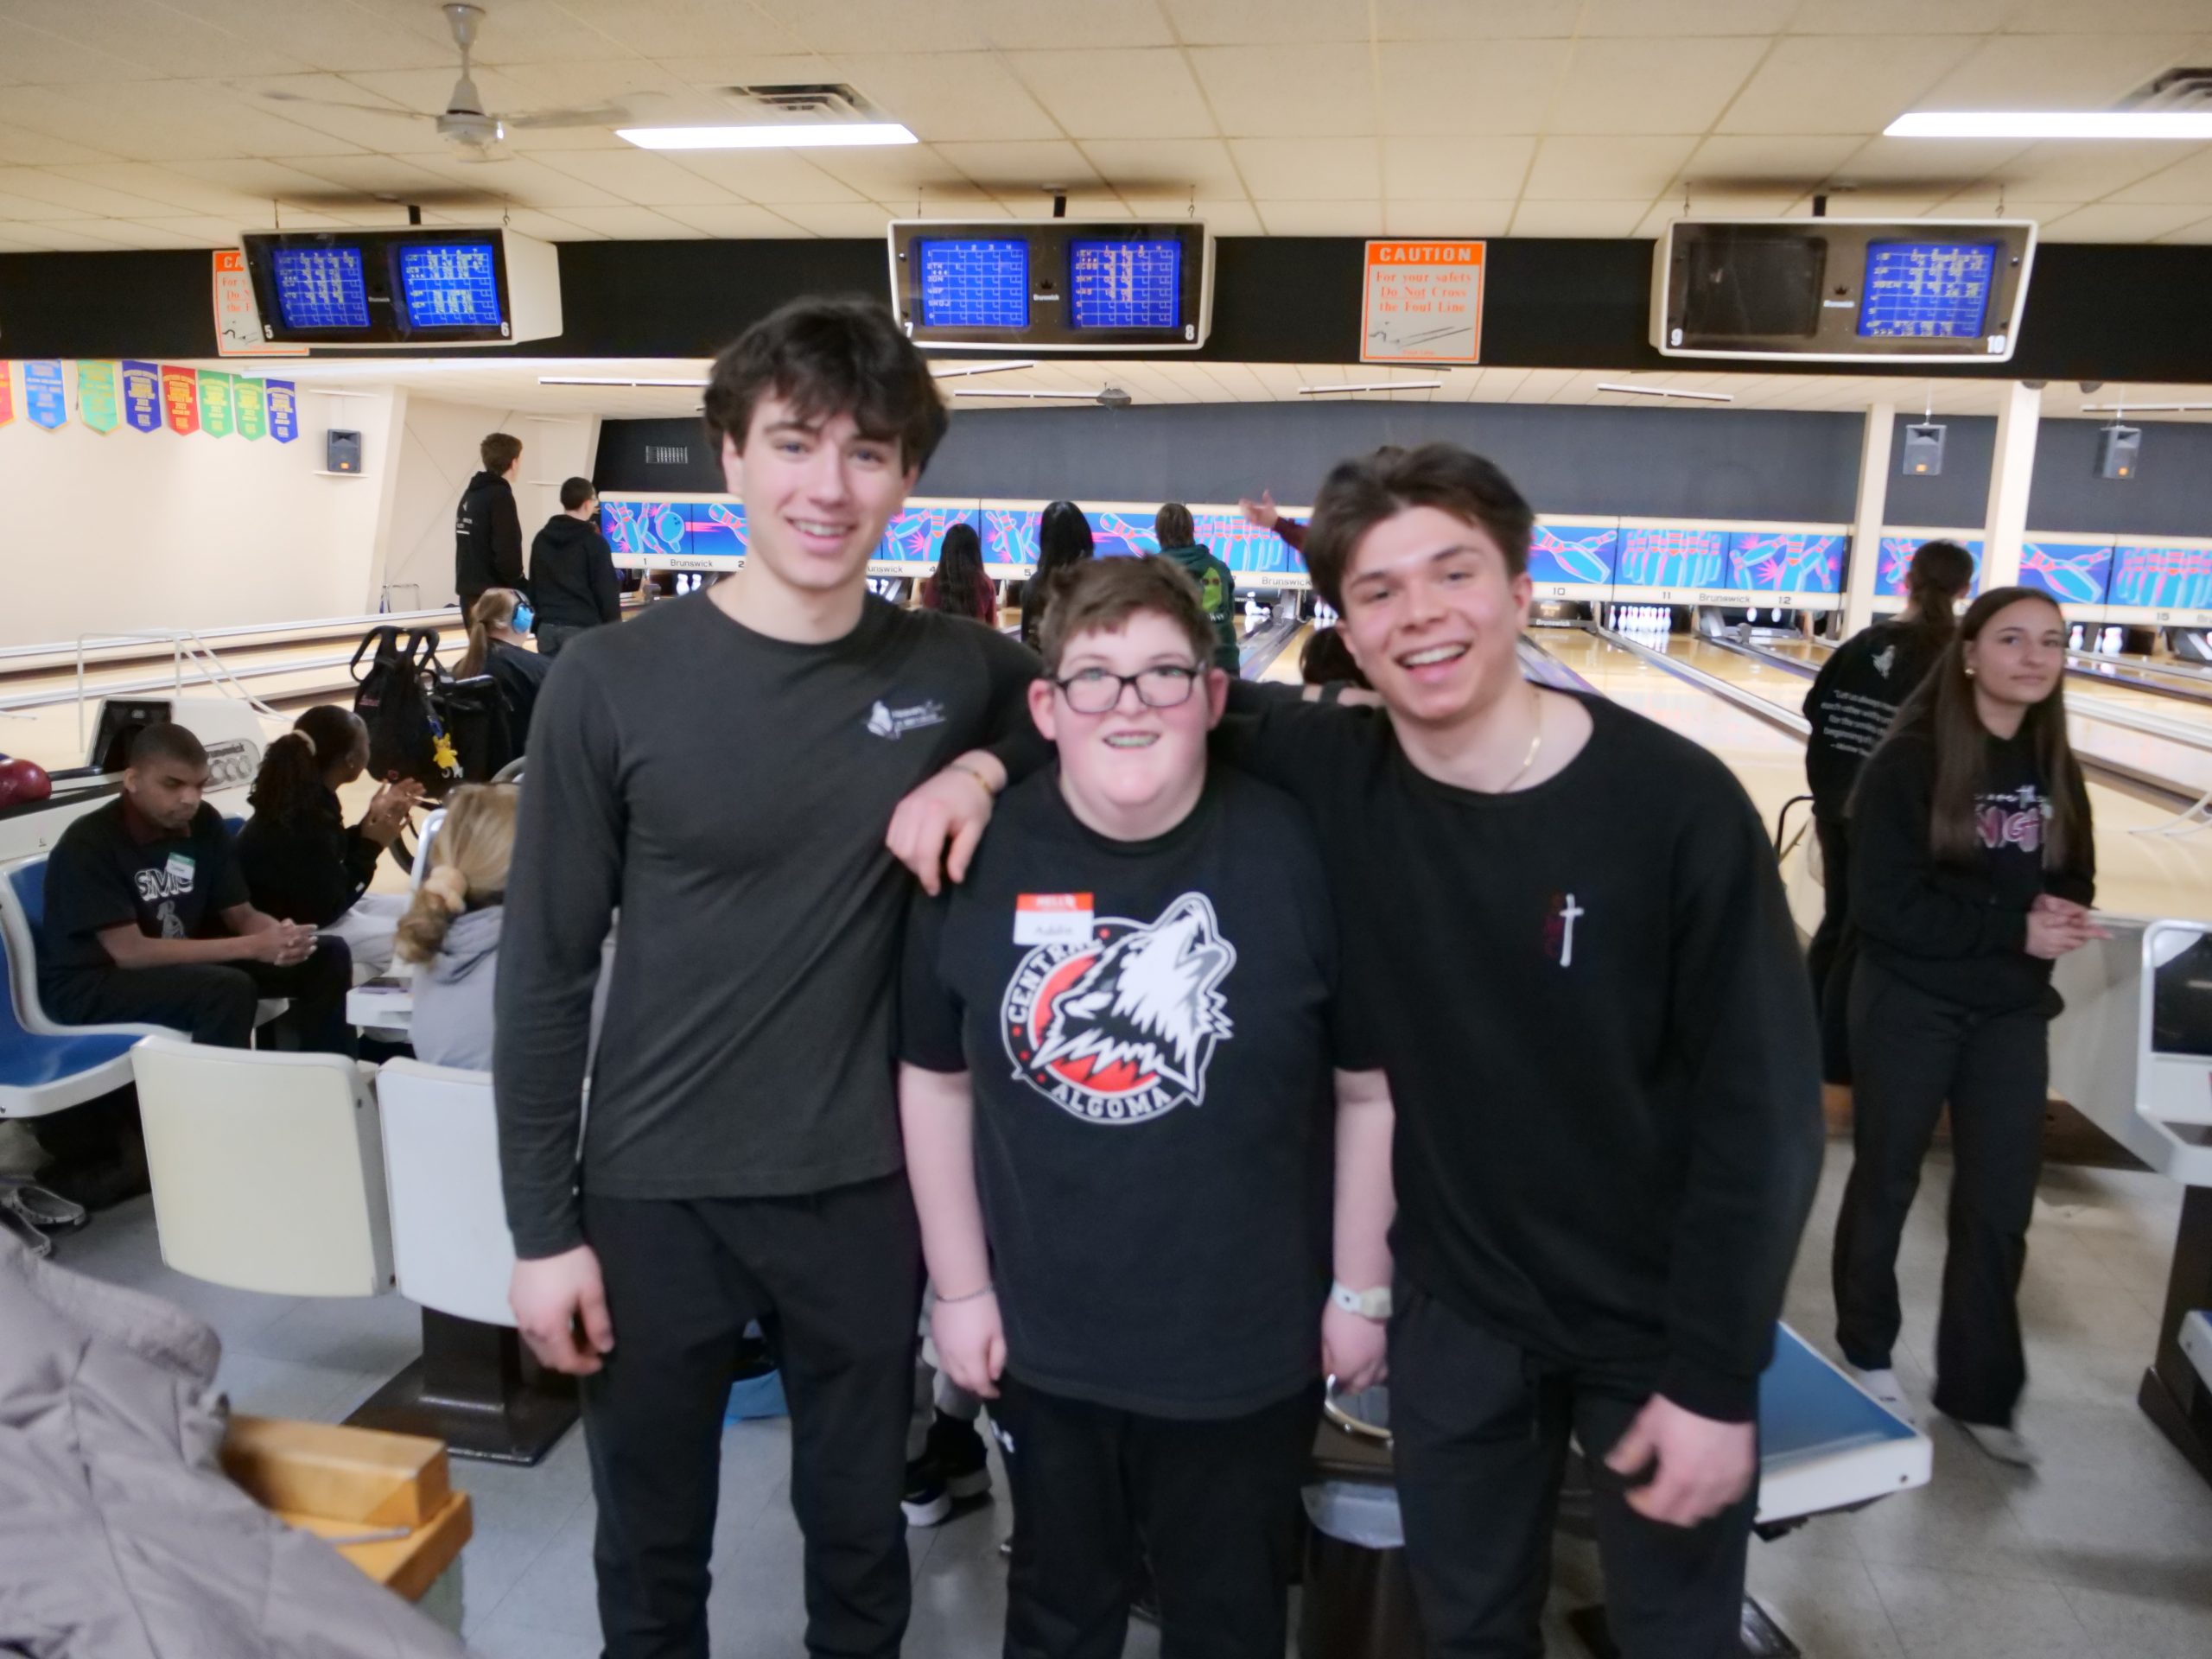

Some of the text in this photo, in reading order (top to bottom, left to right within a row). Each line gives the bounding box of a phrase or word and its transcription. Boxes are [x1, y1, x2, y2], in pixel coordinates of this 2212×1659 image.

[1380, 247, 1471, 262] CAUTION
[1376, 271, 1471, 285] For your safety
[1382, 286, 1466, 298] Do Not Cross
[1380, 302, 1466, 313] the Foul Line
[264, 325, 274, 340] 5
[501, 321, 510, 337] 6
[905, 321, 913, 338] 7
[1185, 324, 1194, 340] 8
[1670, 328, 1682, 346] 9
[1987, 335, 2006, 353] 10
[671, 558, 713, 568] Brunswick
[868, 565, 903, 574] unswick
[1262, 576, 1312, 586] Brunswick
[1699, 593, 1751, 603] Brunswick
[1778, 596, 1791, 605] 12
[1052, 1084, 1172, 1118] ALGOMA
